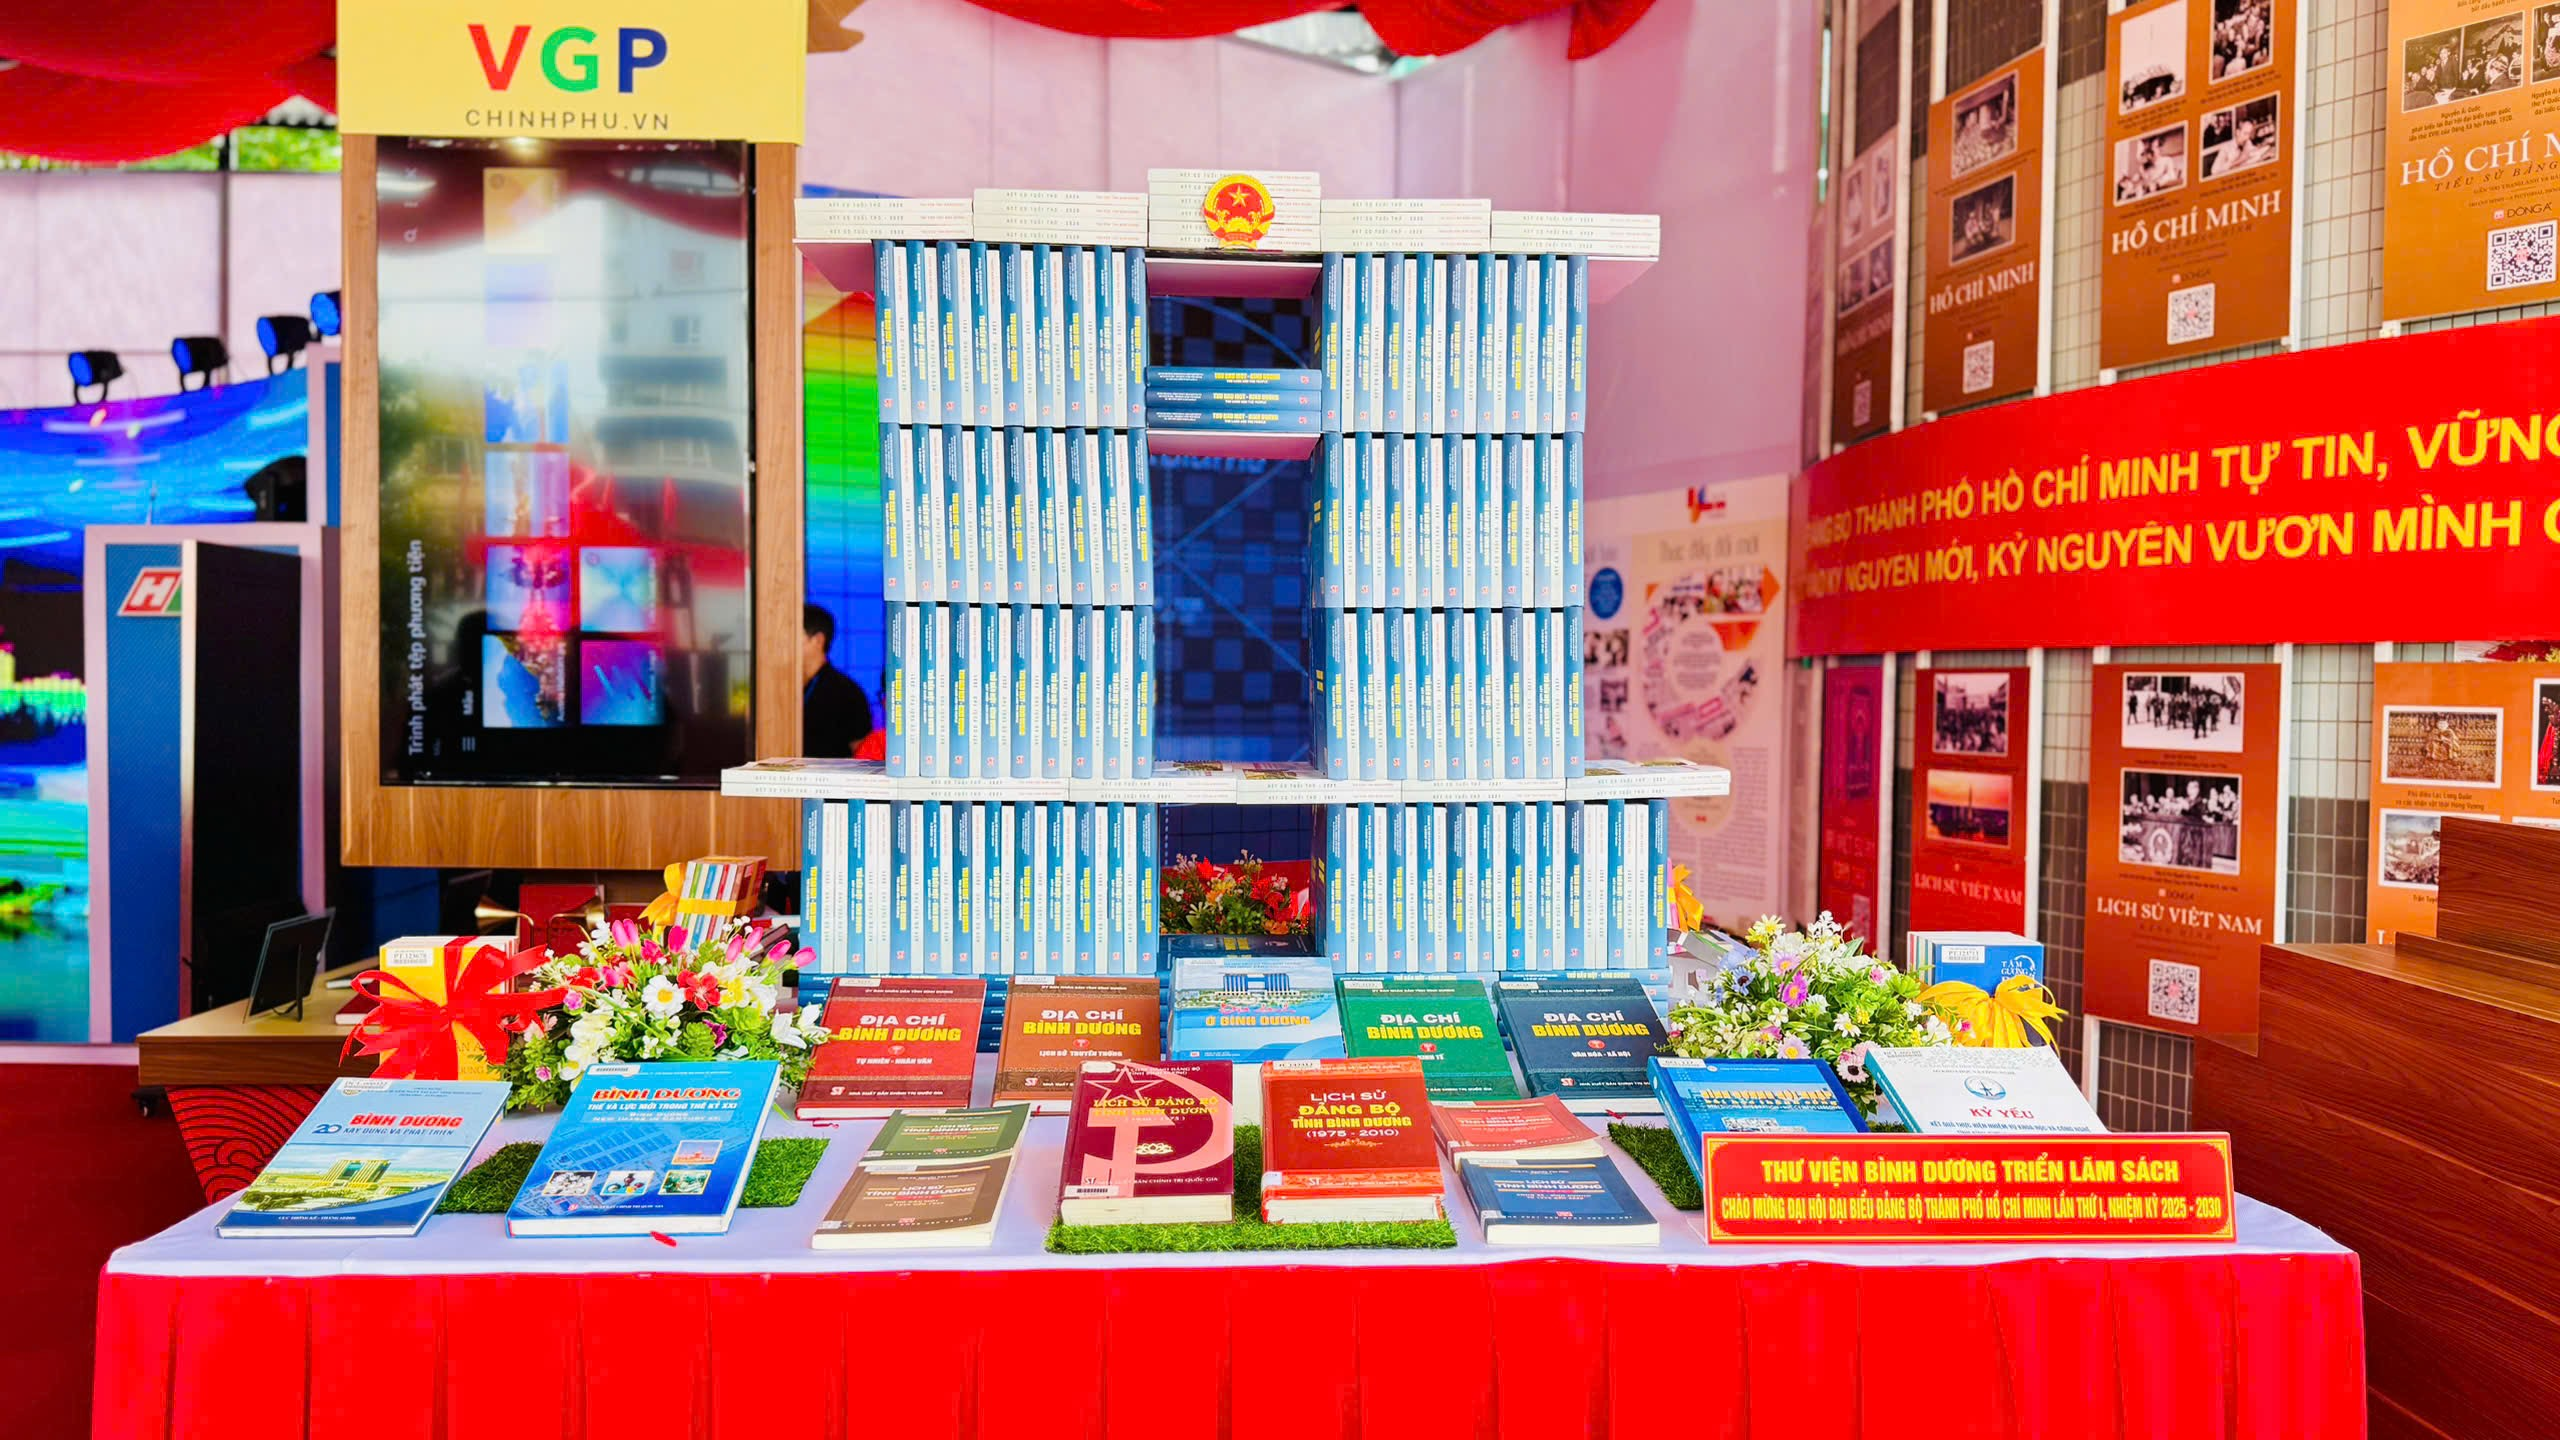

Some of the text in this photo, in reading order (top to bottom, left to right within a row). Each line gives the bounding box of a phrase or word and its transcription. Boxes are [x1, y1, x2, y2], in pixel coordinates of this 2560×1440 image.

[468, 24, 669, 93] VGP
[466, 109, 671, 131] CHINHPHU.VN
[2400, 147, 2453, 186] HỒ
[2465, 130, 2531, 172] CHÍ
[2111, 218, 2148, 255] HỒ
[2153, 205, 2199, 243] CHÍ
[2205, 189, 2282, 232] MINH
[1987, 261, 2035, 296] MINH
[2031, 453, 2089, 507] CHÍ
[2099, 450, 2200, 502] MINH
[2212, 441, 2282, 497] TỰ
[2293, 430, 2389, 482] TIN,
[2036, 522, 2194, 573] NGUYÊN
[2206, 509, 2355, 563] VƯƠN
[2372, 494, 2523, 554] MÌNH
[407, 577, 427, 638] phương
[408, 642, 426, 669] tệp
[408, 675, 426, 710] phát
[409, 715, 424, 756] Trình
[2097, 897, 2263, 936] LỊCH SỬ VIỆT NAM
[859, 1012, 946, 1027] ĐỊA CHÍ
[1041, 1008, 1124, 1022] ĐỊA CHÍ
[1380, 1012, 1460, 1025] ĐỊA CHÍ
[1543, 1011, 1625, 1024] ĐỊA CHÍ
[838, 1025, 962, 1042] BÌNH DƯƠNG
[1022, 1020, 1142, 1036] BÌNH DƯƠNG
[1367, 1024, 1484, 1040] BÌNH DƯƠNG
[1532, 1023, 1650, 1037] BÌNH DƯƠNG
[591, 1085, 742, 1103] BÌNH DƯƠNG
[1093, 1098, 1127, 1108] LỊCH
[1311, 1089, 1387, 1103] LỊCH SỬ
[658, 1102, 689, 1110] TRONG
[1299, 1101, 1400, 1116] ĐẢNG BỘ
[1969, 1103, 2035, 1119] KỶ YẾU
[349, 1111, 464, 1129] BÌNH DƯƠNG
[1290, 1114, 1412, 1129] TỈNH BÌNH DƯƠNG
[1306, 1128, 1400, 1138] (1975 2010)
[1761, 1152, 2180, 1188] THƯ VIỆN BÌNH DƯƠNG TRIỂN LÃM SÁCH
[1722, 1194, 1751, 1220] CHÀO
[1753, 1194, 1786, 1220] MỪNG
[1788, 1197, 1806, 1224] ĐẠI
[1809, 1193, 1827, 1224] HỘI
[1829, 1197, 1848, 1224] ĐẠI
[1850, 1188, 1874, 1220] BIỂU
[1876, 1190, 1906, 1220] ĐẢNG
[1908, 1193, 1923, 1224] BỘ
[1925, 1193, 1960, 1220] THÀNH
[1962, 1189, 1983, 1219] PHỐ
[1985, 1189, 2000, 1219] HỒ
[2002, 1192, 2021, 1219] CHÍ
[2023, 1196, 2051, 1219] MINH
[2053, 1190, 2077, 1219] LẦN
[2077, 1193, 2098, 1219] THỨ
[2108, 1193, 2143, 1223] NHIỆM
[2144, 1192, 2159, 1219] KỲ
[2161, 1196, 2187, 1219] 2025
[2196, 1196, 2222, 1219] 2030
